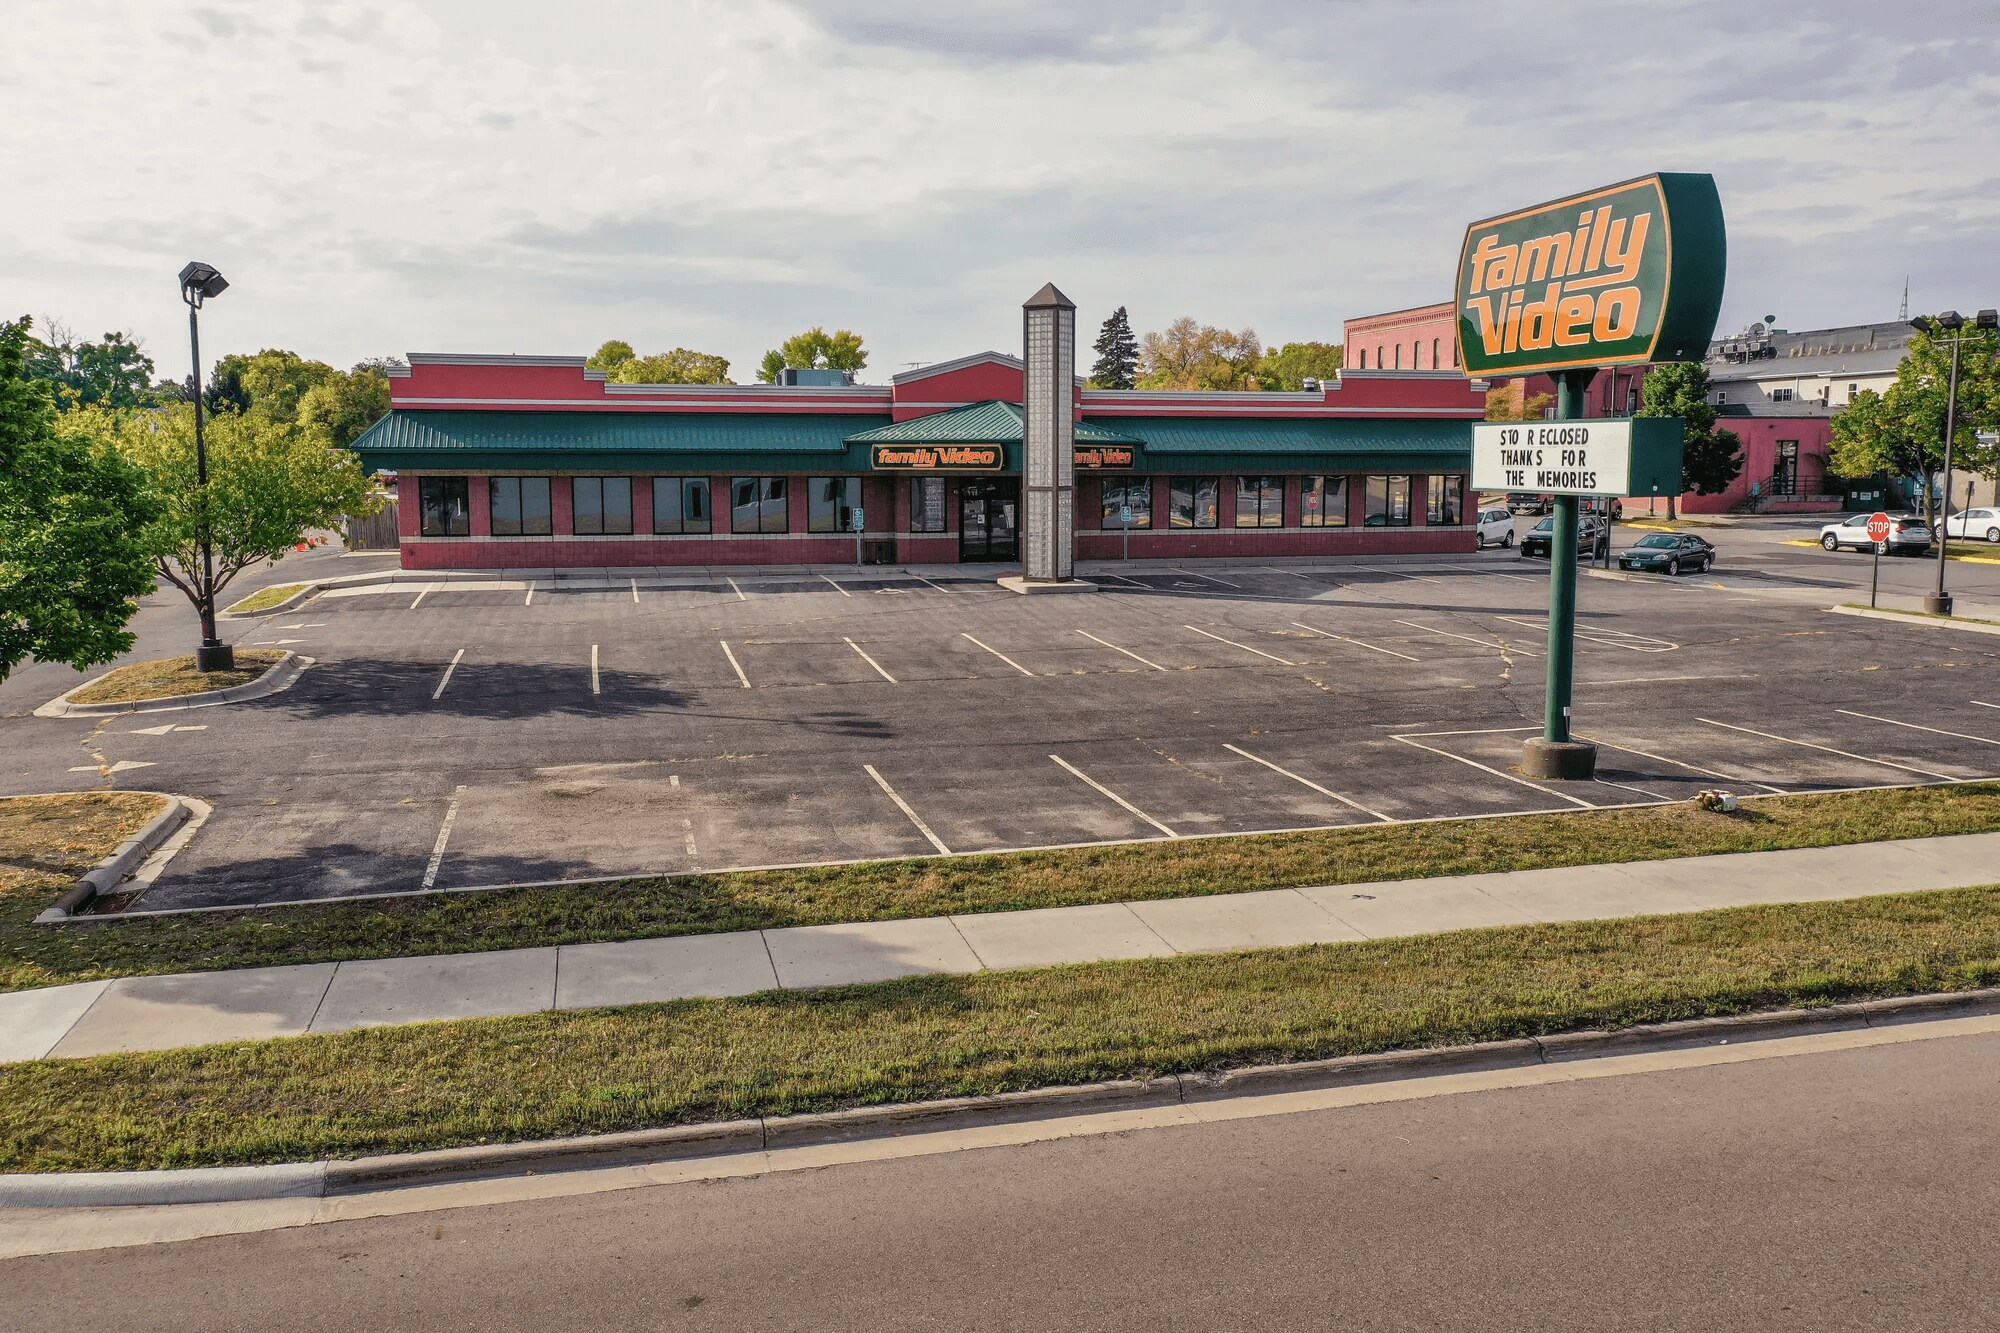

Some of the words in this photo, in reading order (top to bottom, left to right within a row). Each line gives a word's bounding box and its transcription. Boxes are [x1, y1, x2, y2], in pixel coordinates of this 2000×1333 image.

[1470, 205, 1651, 294] family
[1465, 282, 1641, 356] Video
[878, 448, 937, 467] family
[934, 447, 995, 464] Video
[1075, 449, 1102, 467] amily
[1100, 448, 1131, 464] Video
[1561, 449, 1586, 467] FOR
[1506, 470, 1525, 486] THE
[1537, 471, 1597, 489] MEMORIES
[1868, 521, 1889, 533] STOP
